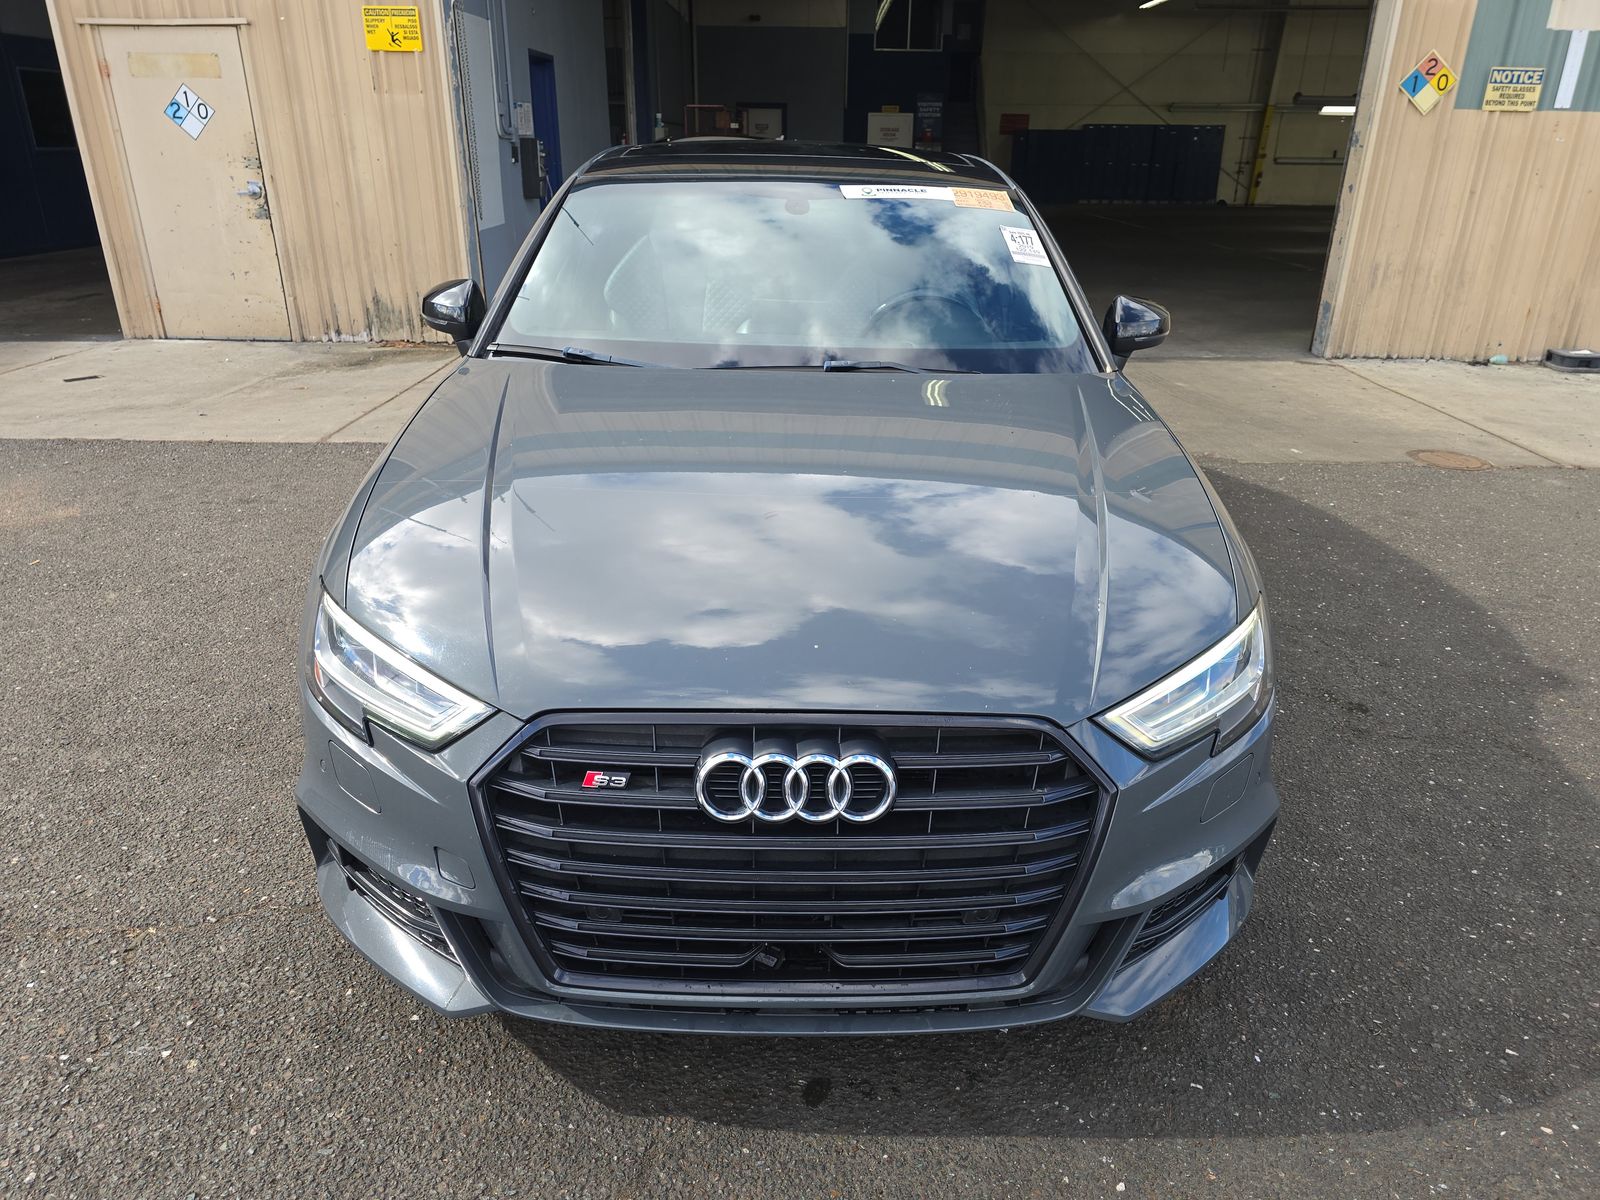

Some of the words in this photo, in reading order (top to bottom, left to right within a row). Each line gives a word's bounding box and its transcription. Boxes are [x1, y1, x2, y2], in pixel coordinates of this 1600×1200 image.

[1425, 58, 1438, 76] 2
[1412, 75, 1419, 93] 1
[1437, 73, 1449, 92] 0
[1491, 70, 1543, 84] NOTICE
[183, 90, 190, 108] 1
[170, 102, 183, 119] 2
[197, 102, 209, 120] 0
[1010, 234, 1034, 246] 4:177
[591, 775, 627, 787] S3
